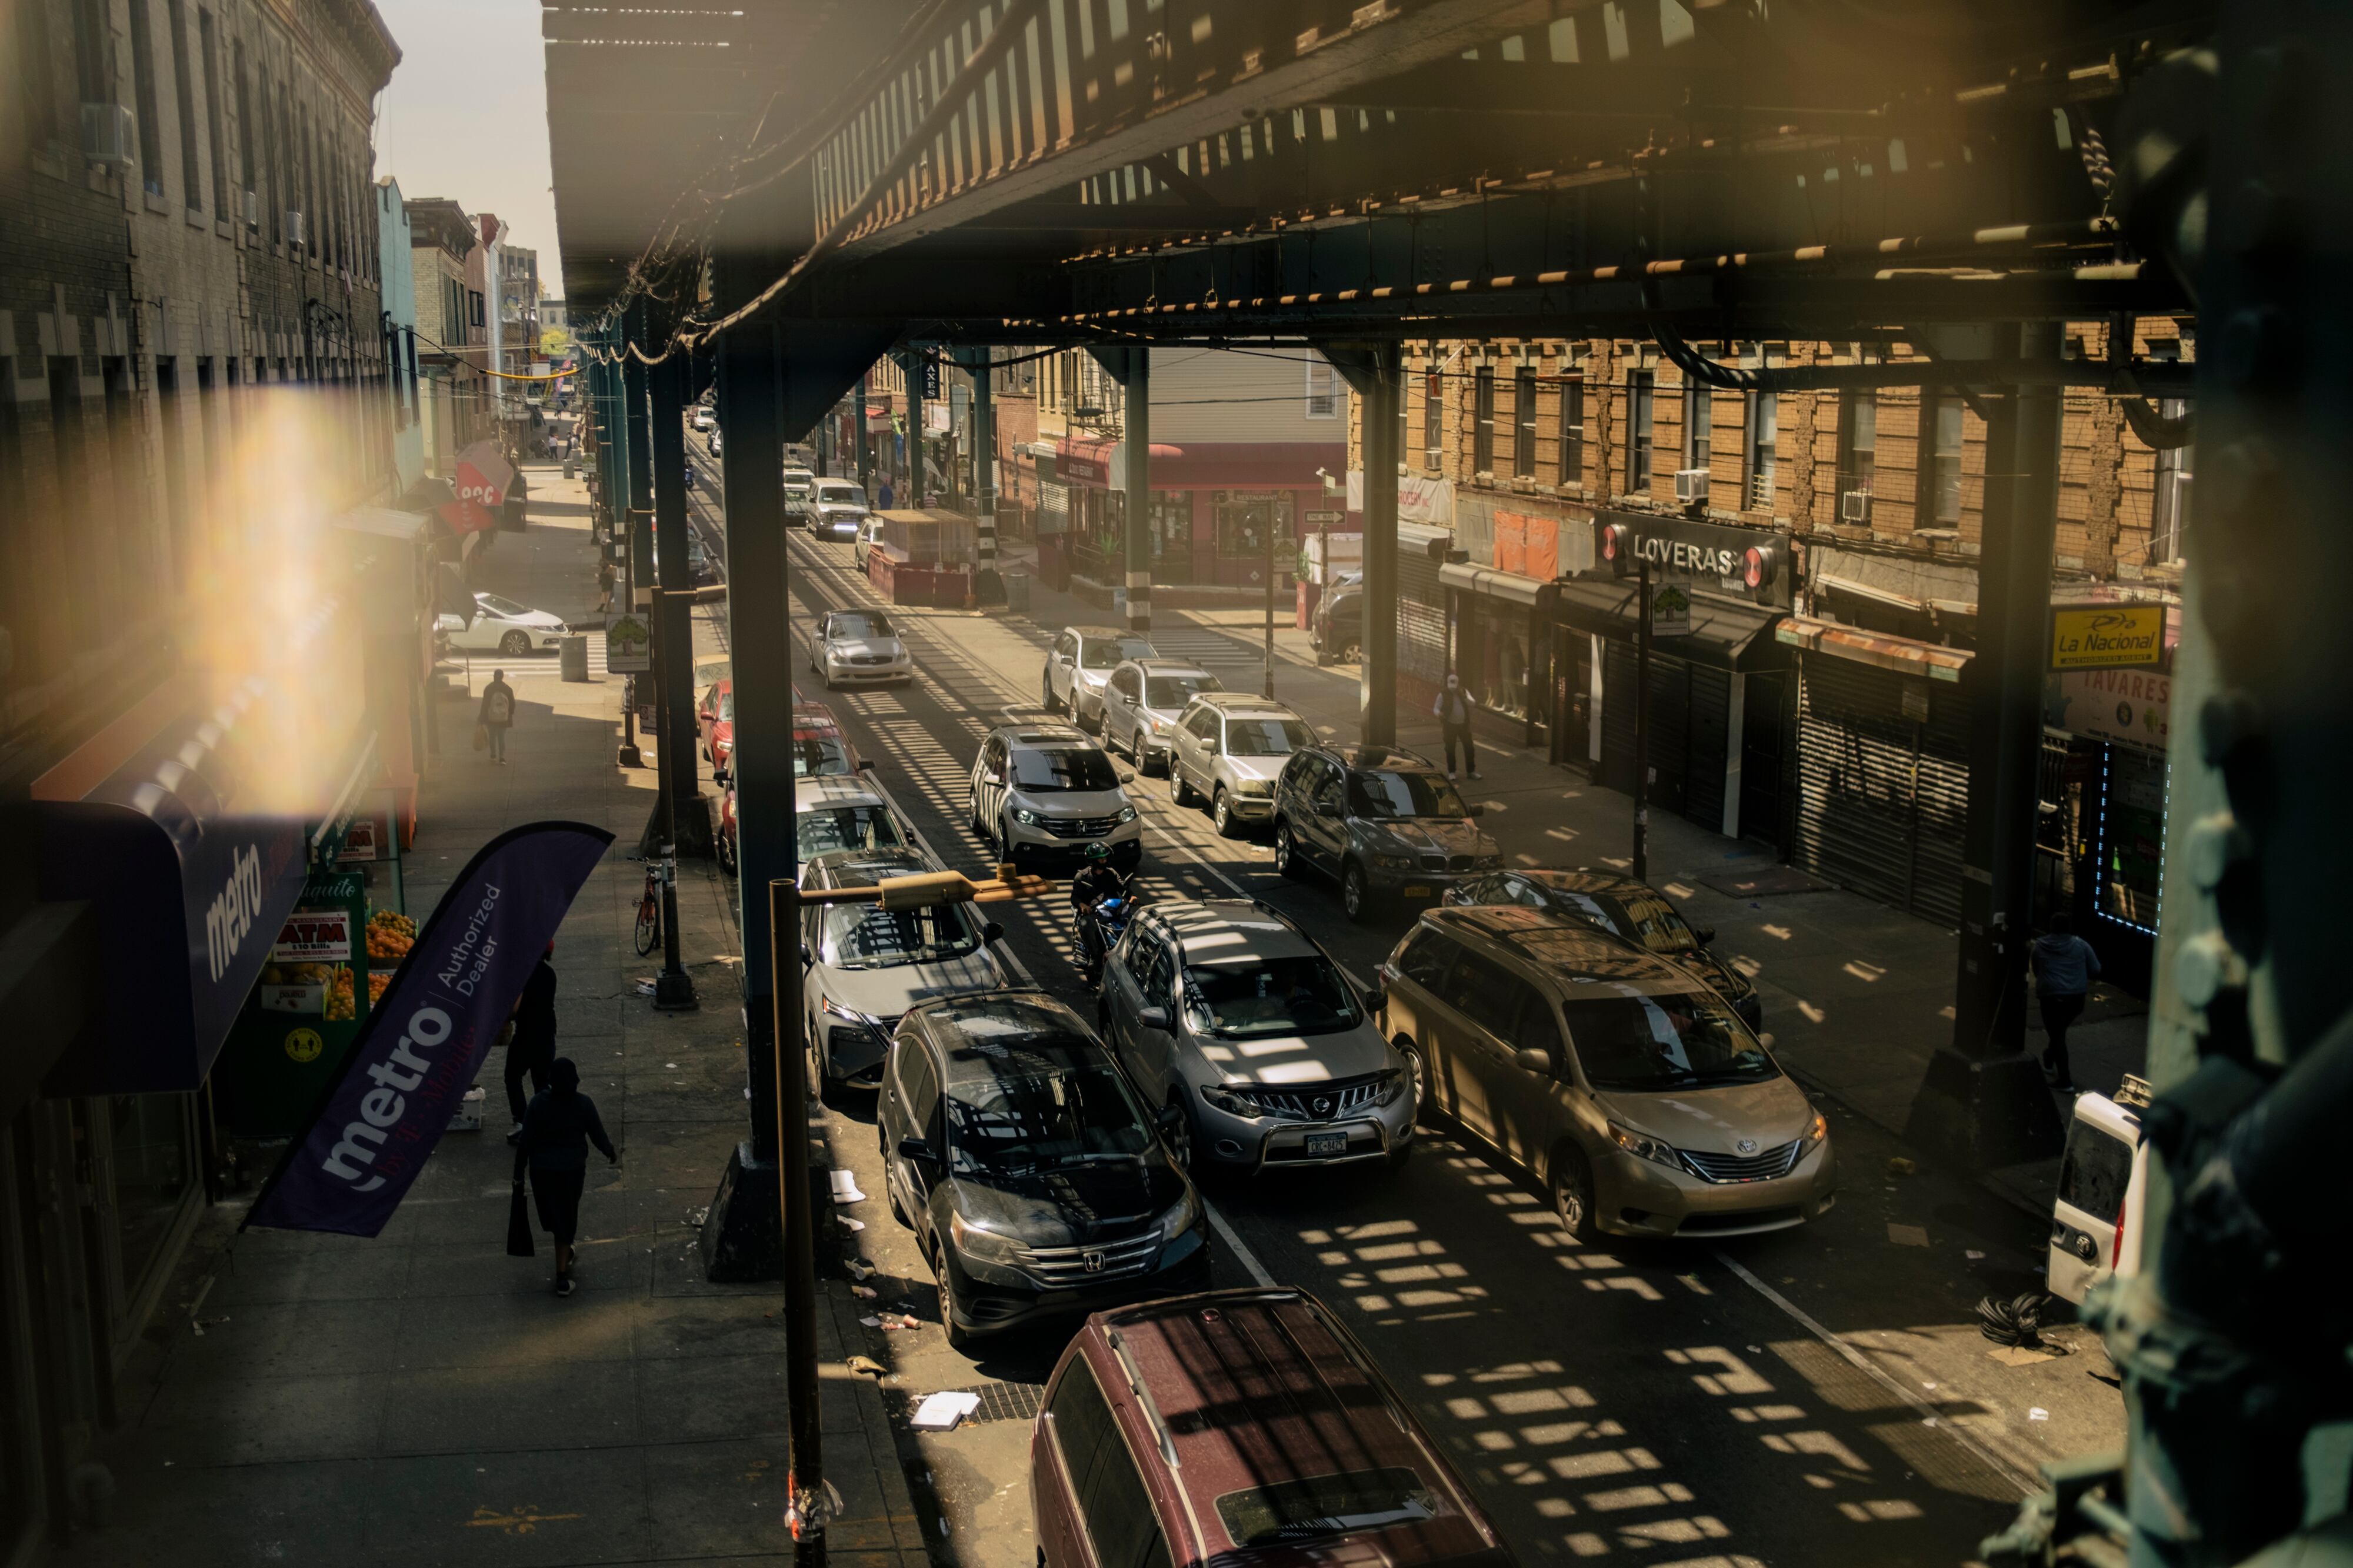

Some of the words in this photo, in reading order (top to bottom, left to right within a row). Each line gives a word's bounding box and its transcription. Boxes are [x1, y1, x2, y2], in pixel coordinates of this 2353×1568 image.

[926, 361, 936, 397] AXES
[1634, 535, 1732, 575] LOVERAS
[1722, 578, 1745, 592] LOUNGE
[2059, 635, 2079, 653] La
[2084, 632, 2155, 652] Nacional
[2064, 655, 2118, 664] AUTHORIZED
[2120, 653, 2149, 662] AGENT
[206, 843, 261, 983] metro
[276, 923, 346, 943] ATM
[438, 883, 501, 988] Authorized
[456, 935, 498, 997] Dealer
[322, 1007, 452, 1192] metro
[376, 1147, 411, 1179] by
